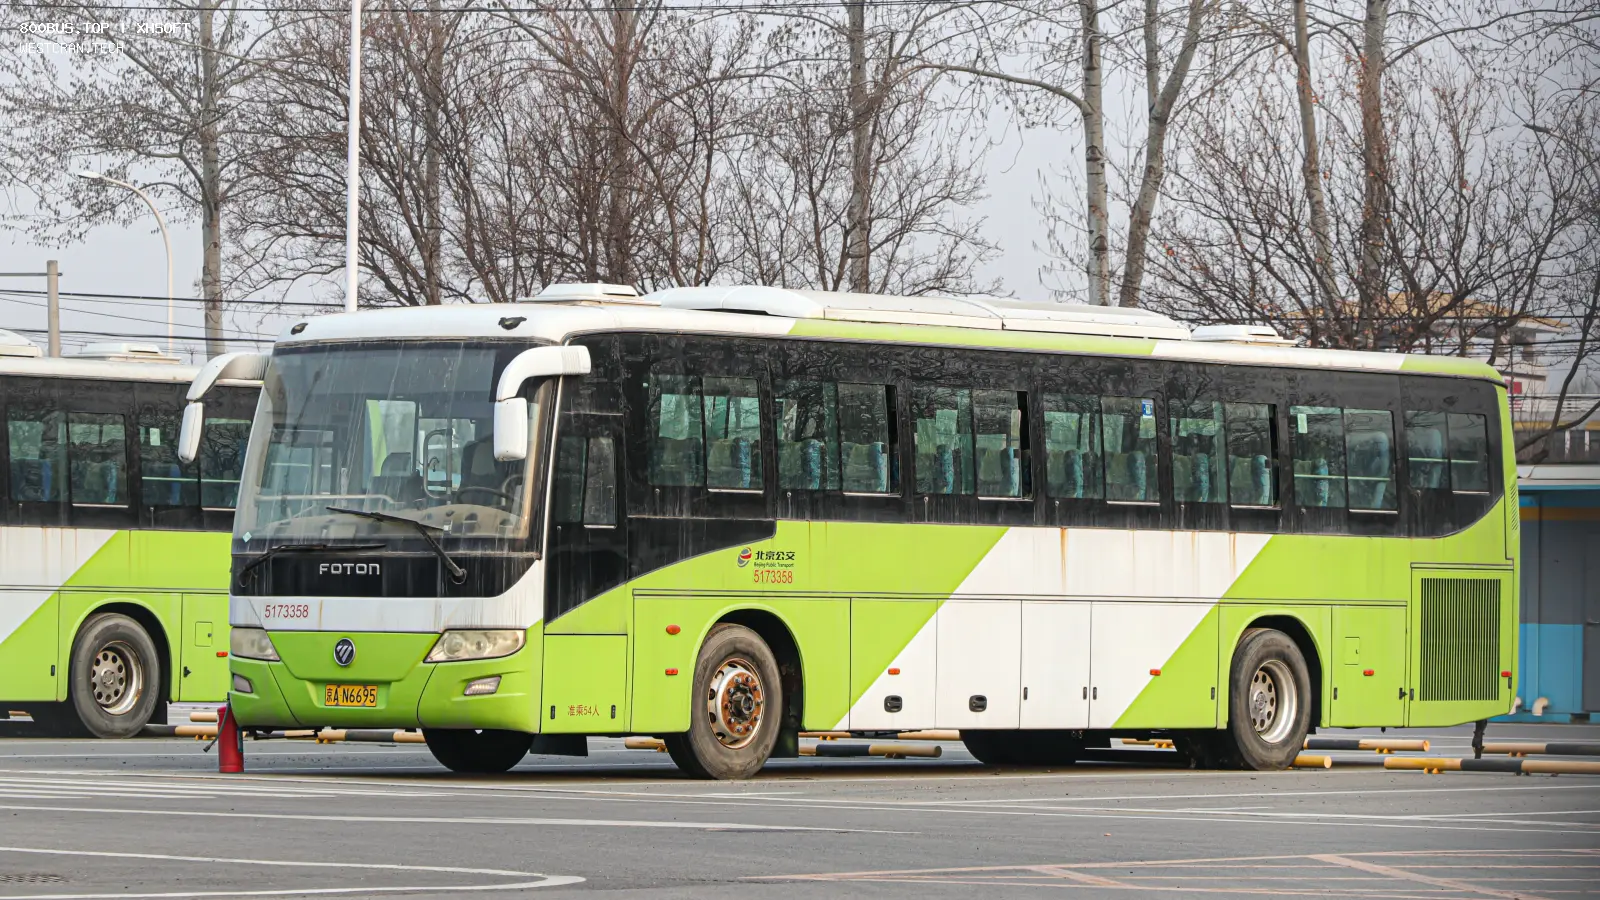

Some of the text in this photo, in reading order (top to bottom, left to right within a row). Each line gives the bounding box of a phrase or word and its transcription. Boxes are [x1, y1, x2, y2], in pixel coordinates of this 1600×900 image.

[755, 551, 796, 560] 北京公交
[319, 563, 380, 575] FOTON
[753, 569, 793, 583] 5173358
[264, 604, 309, 618] 5173358
[567, 704, 599, 716] 准乘54人
